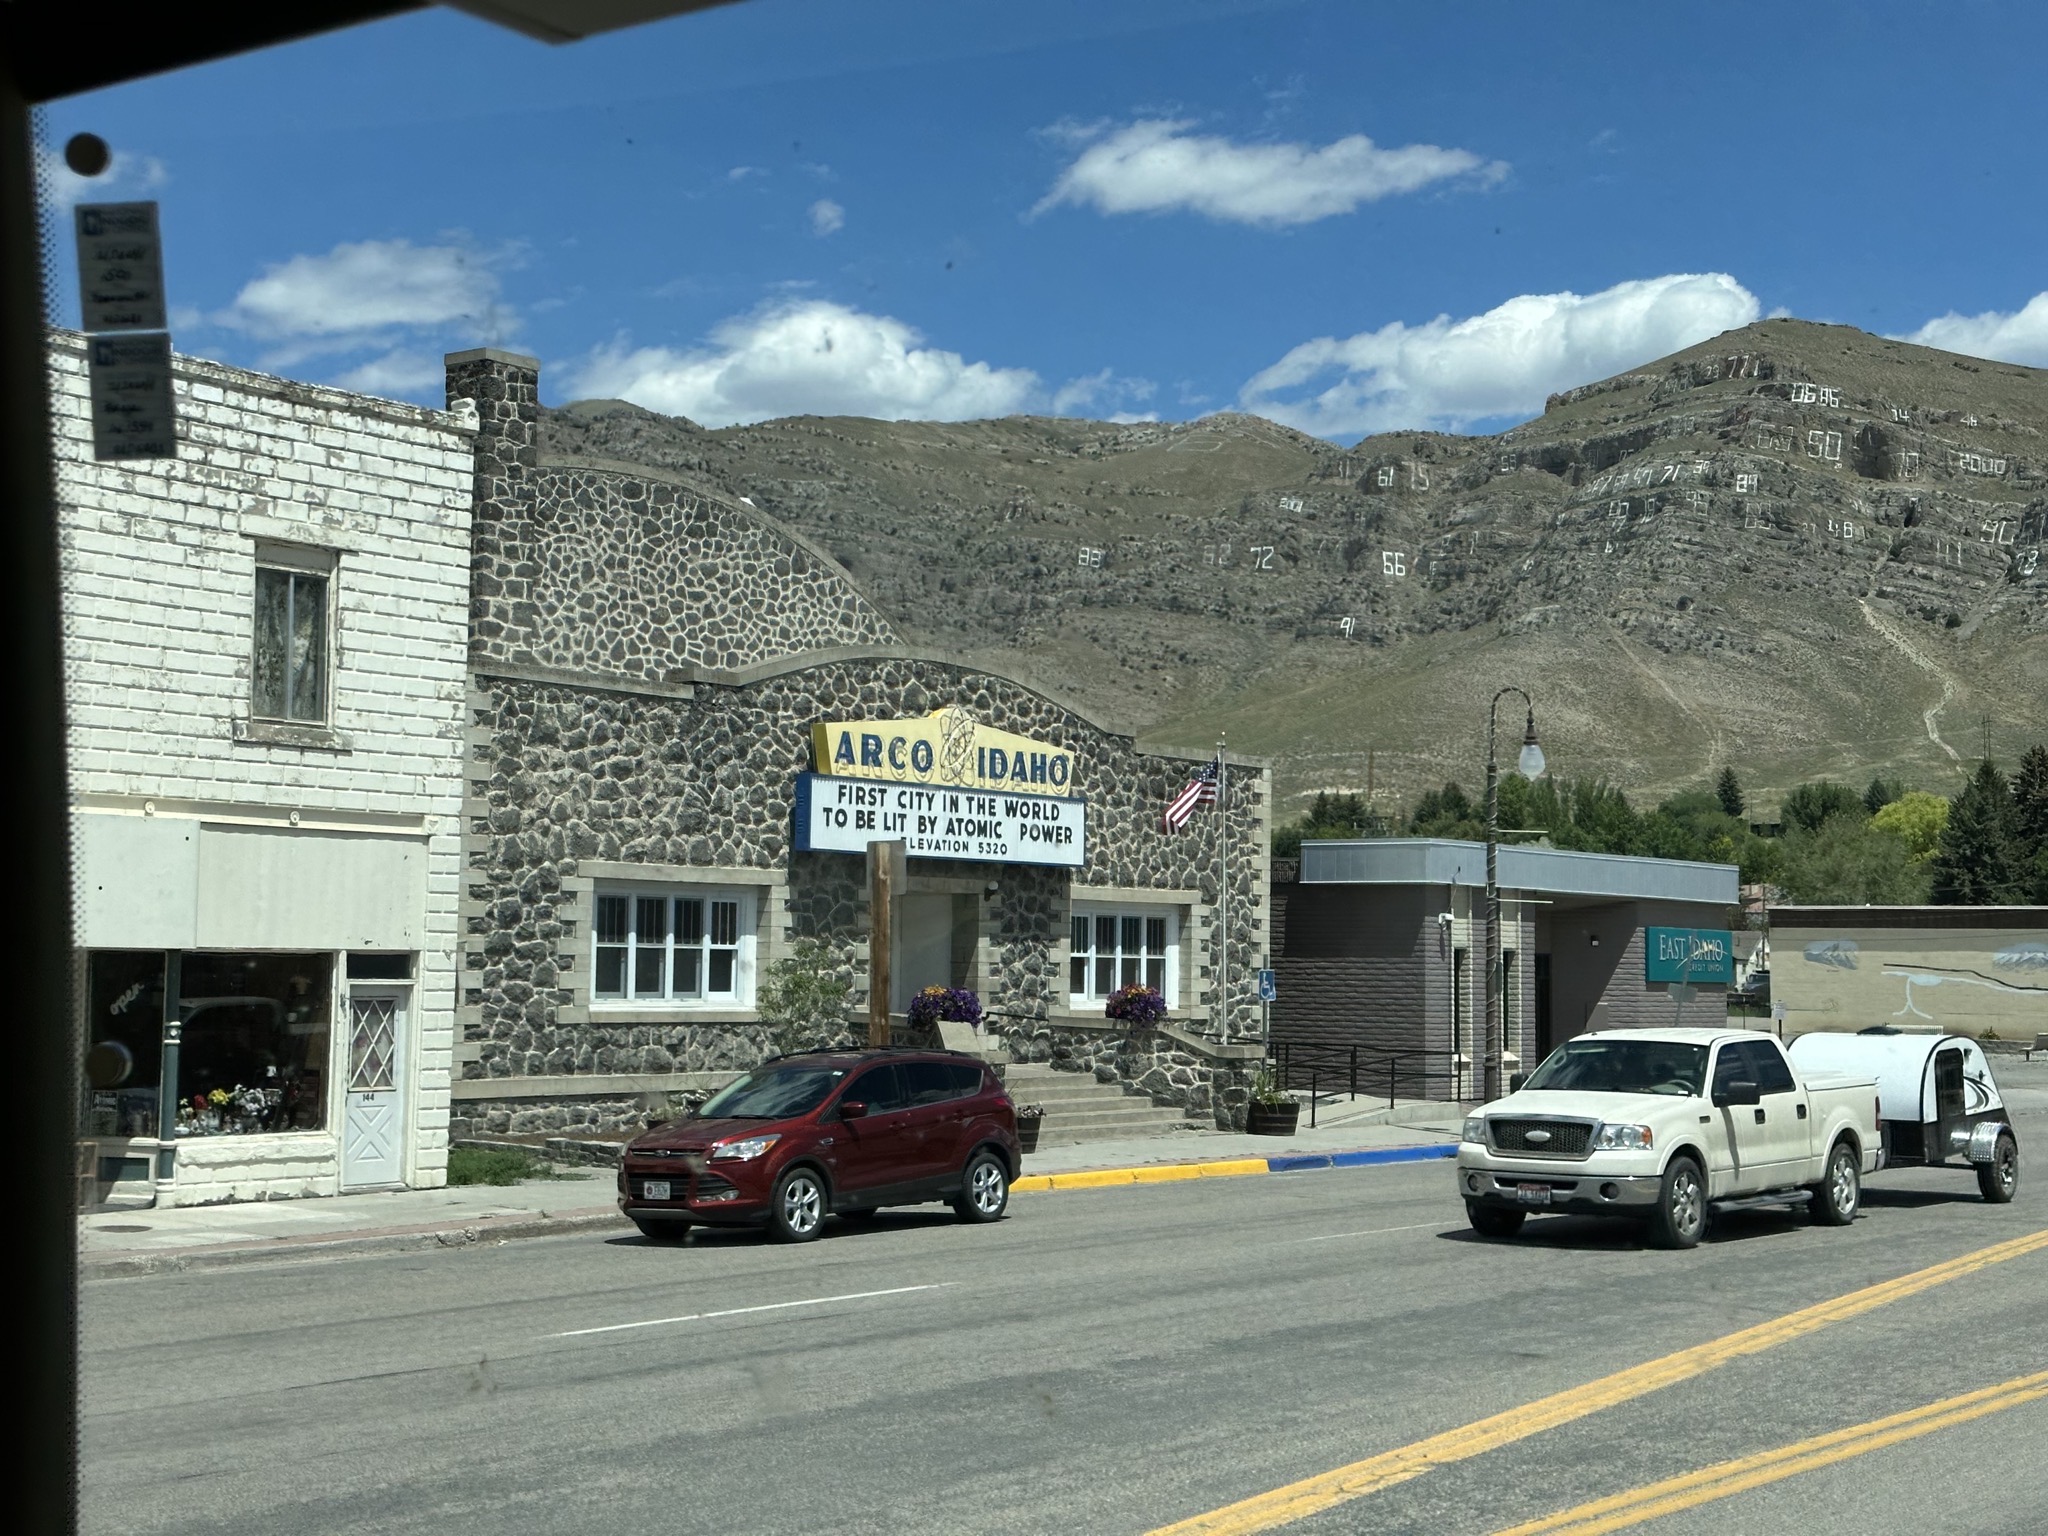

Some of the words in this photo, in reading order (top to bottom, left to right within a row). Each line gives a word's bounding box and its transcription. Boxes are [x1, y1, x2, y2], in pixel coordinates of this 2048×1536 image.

[1806, 429, 1843, 461] 50
[1377, 466, 1394, 487] 61
[1659, 464, 1680, 484] 71
[1250, 546, 1274, 569] 72
[1382, 551, 1406, 576] 66
[834, 731, 934, 773] ARCO
[978, 746, 1070, 787] IDAHO
[838, 784, 888, 808] FIRST
[897, 790, 936, 812] CITY
[943, 793, 960, 814] IN
[966, 796, 997, 817] THE
[1004, 799, 1060, 821] WORLD
[823, 807, 848, 828] TO
[855, 810, 876, 830] BE
[883, 811, 907, 833] LIT
[917, 815, 938, 836] BY
[946, 817, 1003, 840] ATOMIC
[1020, 824, 1073, 845] POWER
[978, 840, 1008, 856] 5320
[1659, 934, 1687, 961] EAST
[109, 983, 145, 1015] open
[362, 1093, 375, 1102] 144
